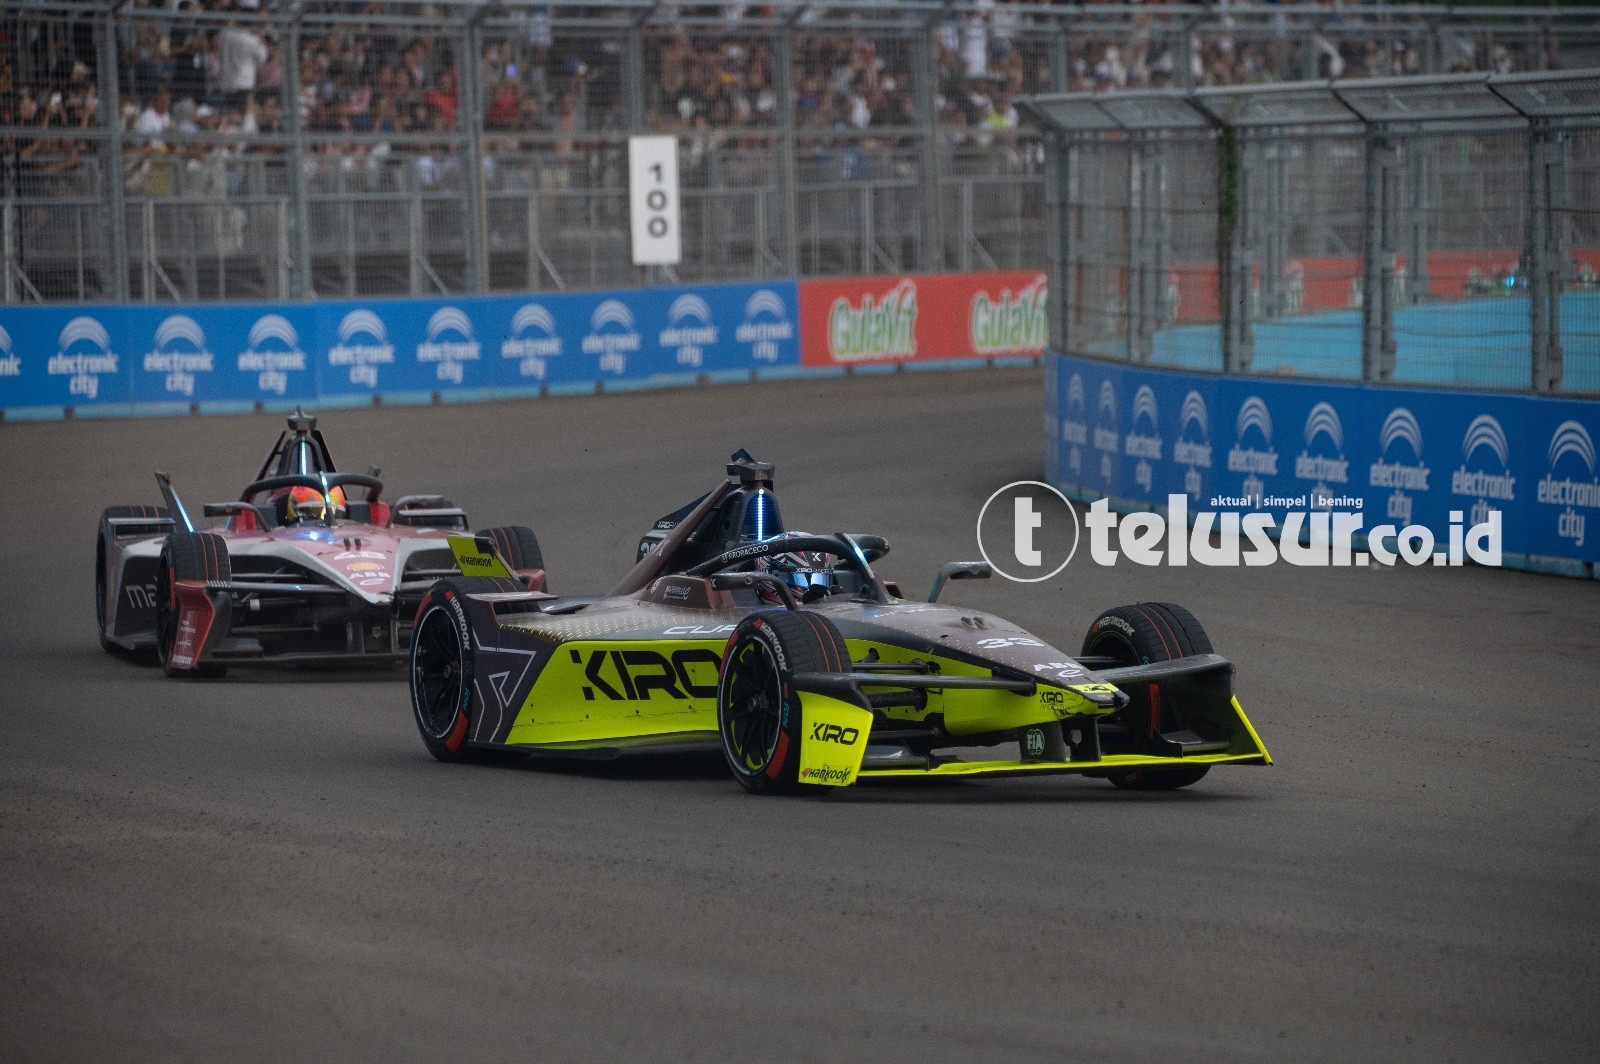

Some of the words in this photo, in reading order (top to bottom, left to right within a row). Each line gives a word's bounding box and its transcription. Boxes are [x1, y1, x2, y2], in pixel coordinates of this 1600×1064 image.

[648, 163, 668, 238] 100
[970, 274, 1047, 355] GulaVi
[48, 352, 118, 375] electronic
[329, 343, 394, 364] electronic
[70, 374, 98, 399] city
[166, 371, 194, 396] city
[259, 370, 287, 395] city
[349, 364, 377, 388] city
[1295, 449, 1349, 484] electronic
[1370, 457, 1430, 491] electronic
[1452, 464, 1515, 500] electronic
[1387, 489, 1412, 527] city
[1558, 506, 1585, 546] city
[663, 624, 740, 635] CUP
